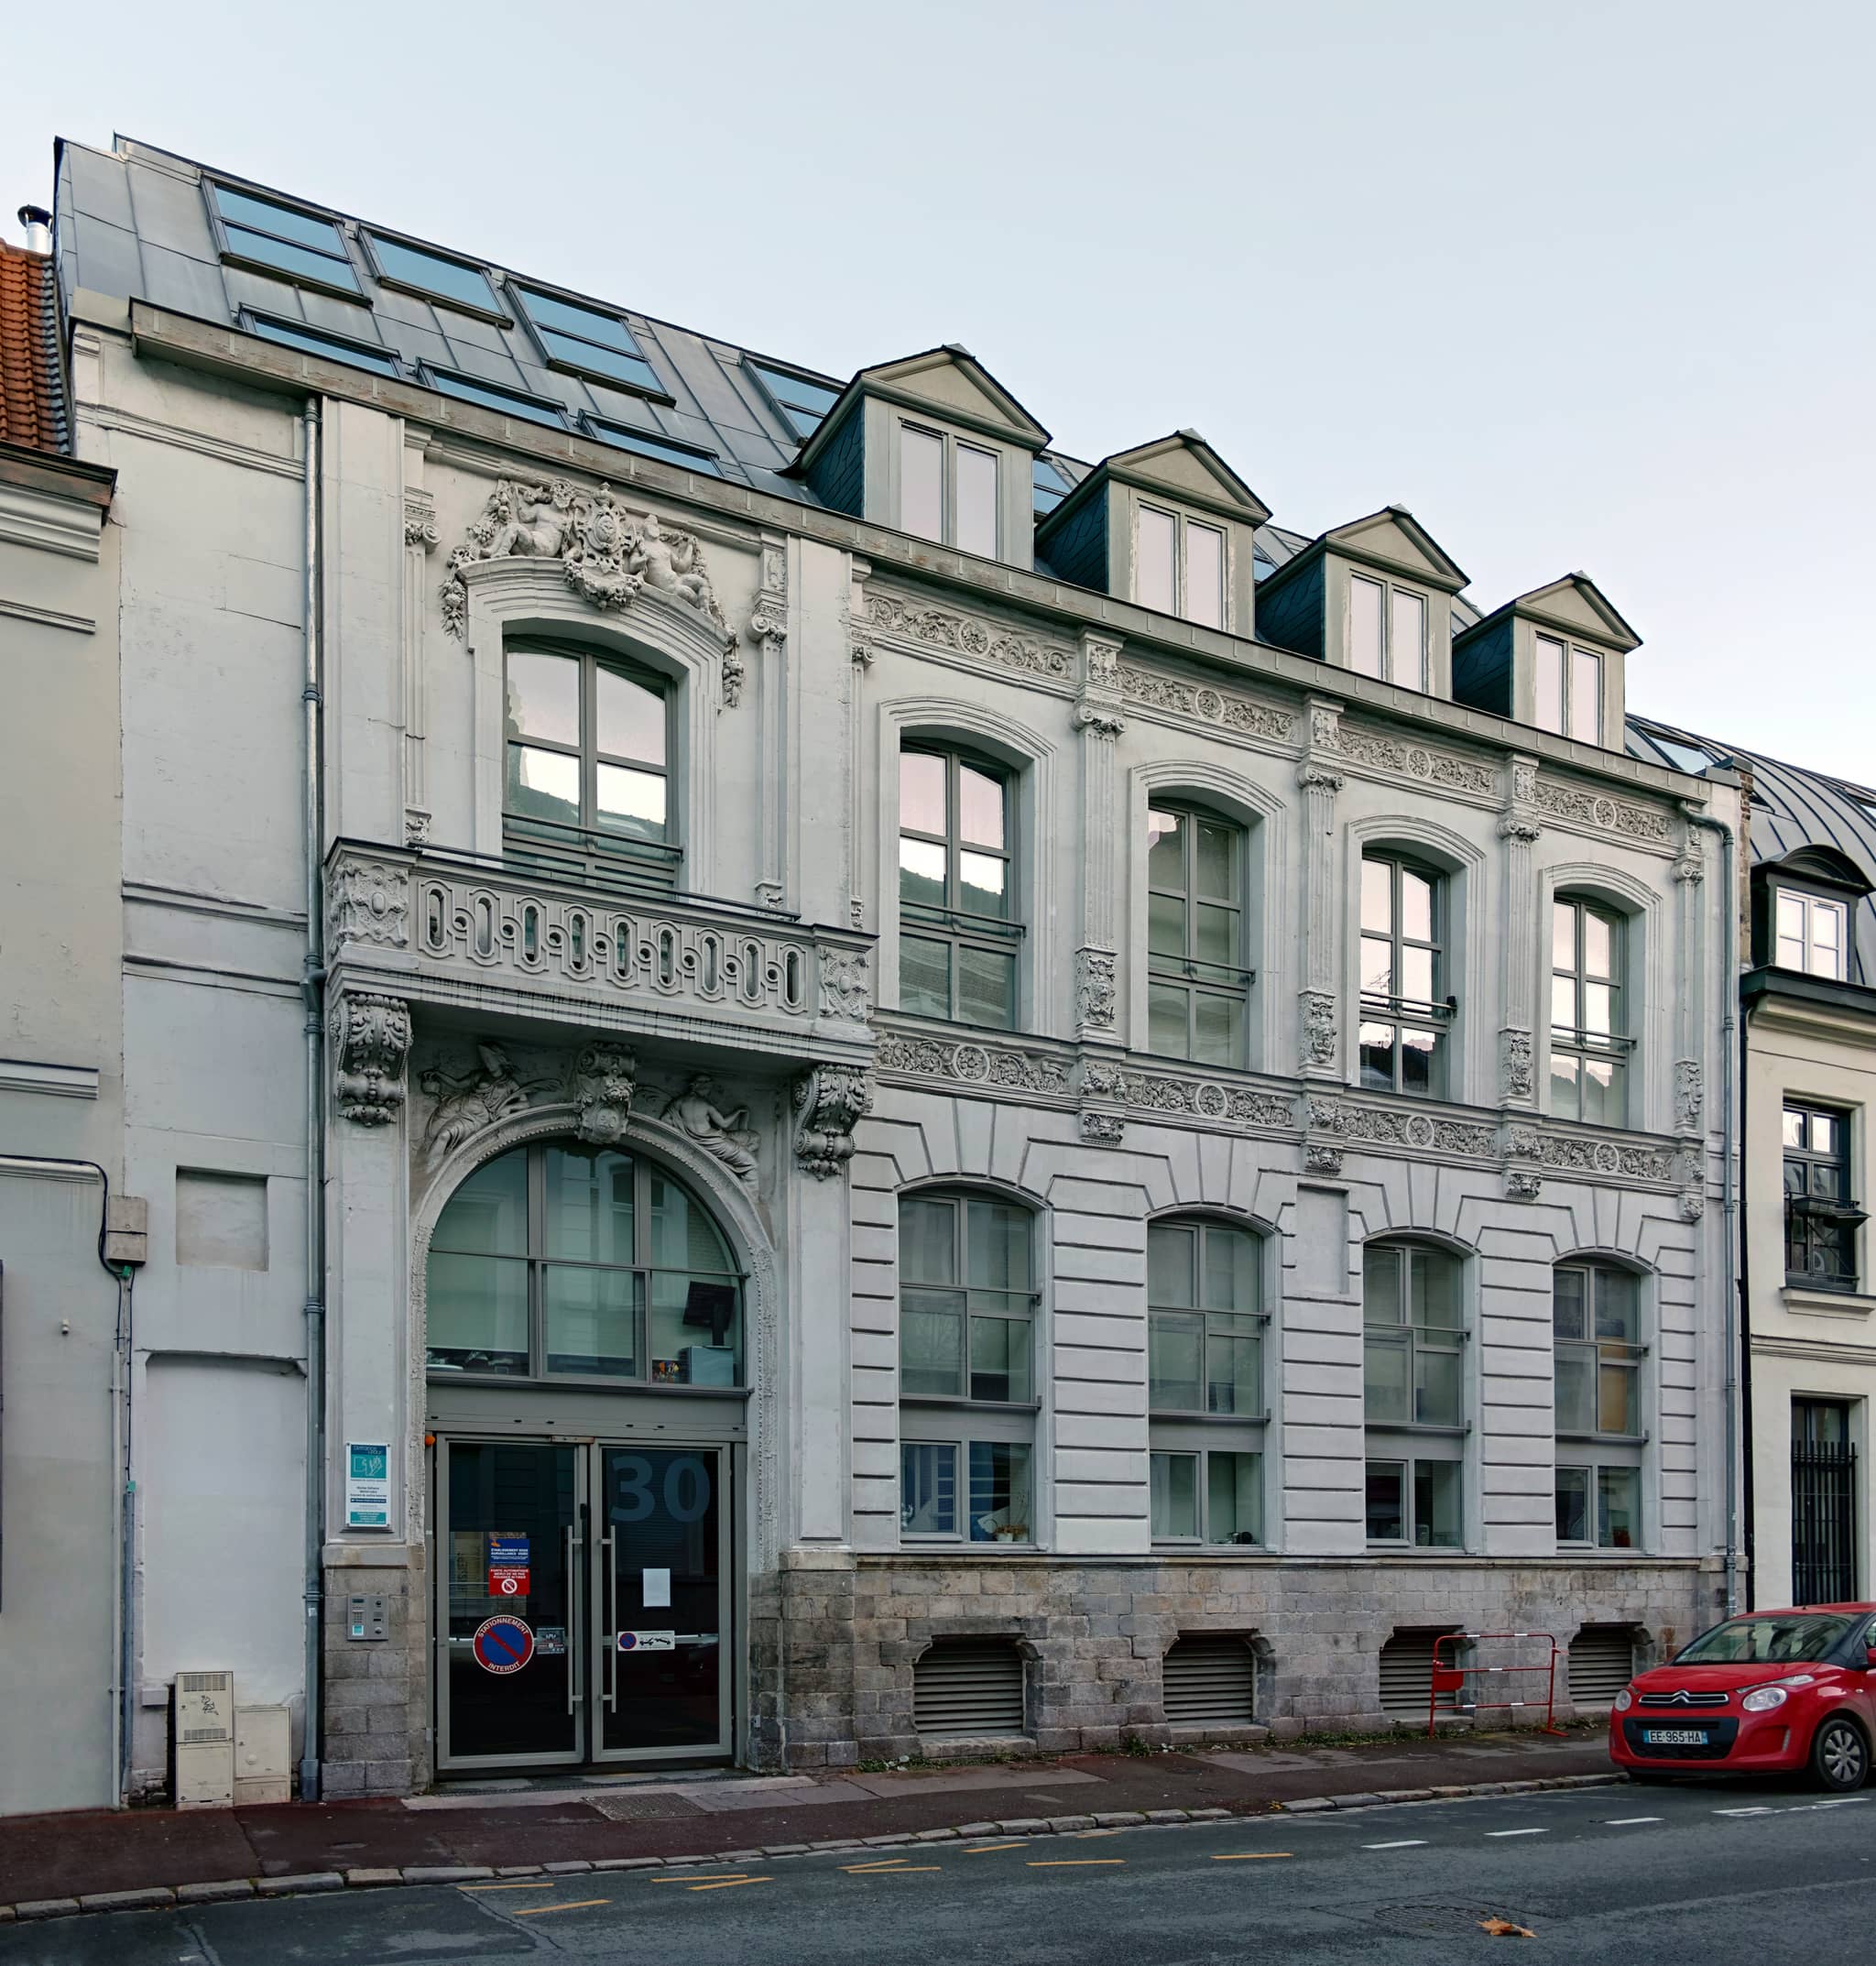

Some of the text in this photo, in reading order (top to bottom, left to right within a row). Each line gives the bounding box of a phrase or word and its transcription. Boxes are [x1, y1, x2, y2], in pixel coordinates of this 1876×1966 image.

[610, 1455, 710, 1522] 30
[478, 1617, 529, 1638] STATIONNEMENT
[487, 1661, 520, 1672] INTERDIT
